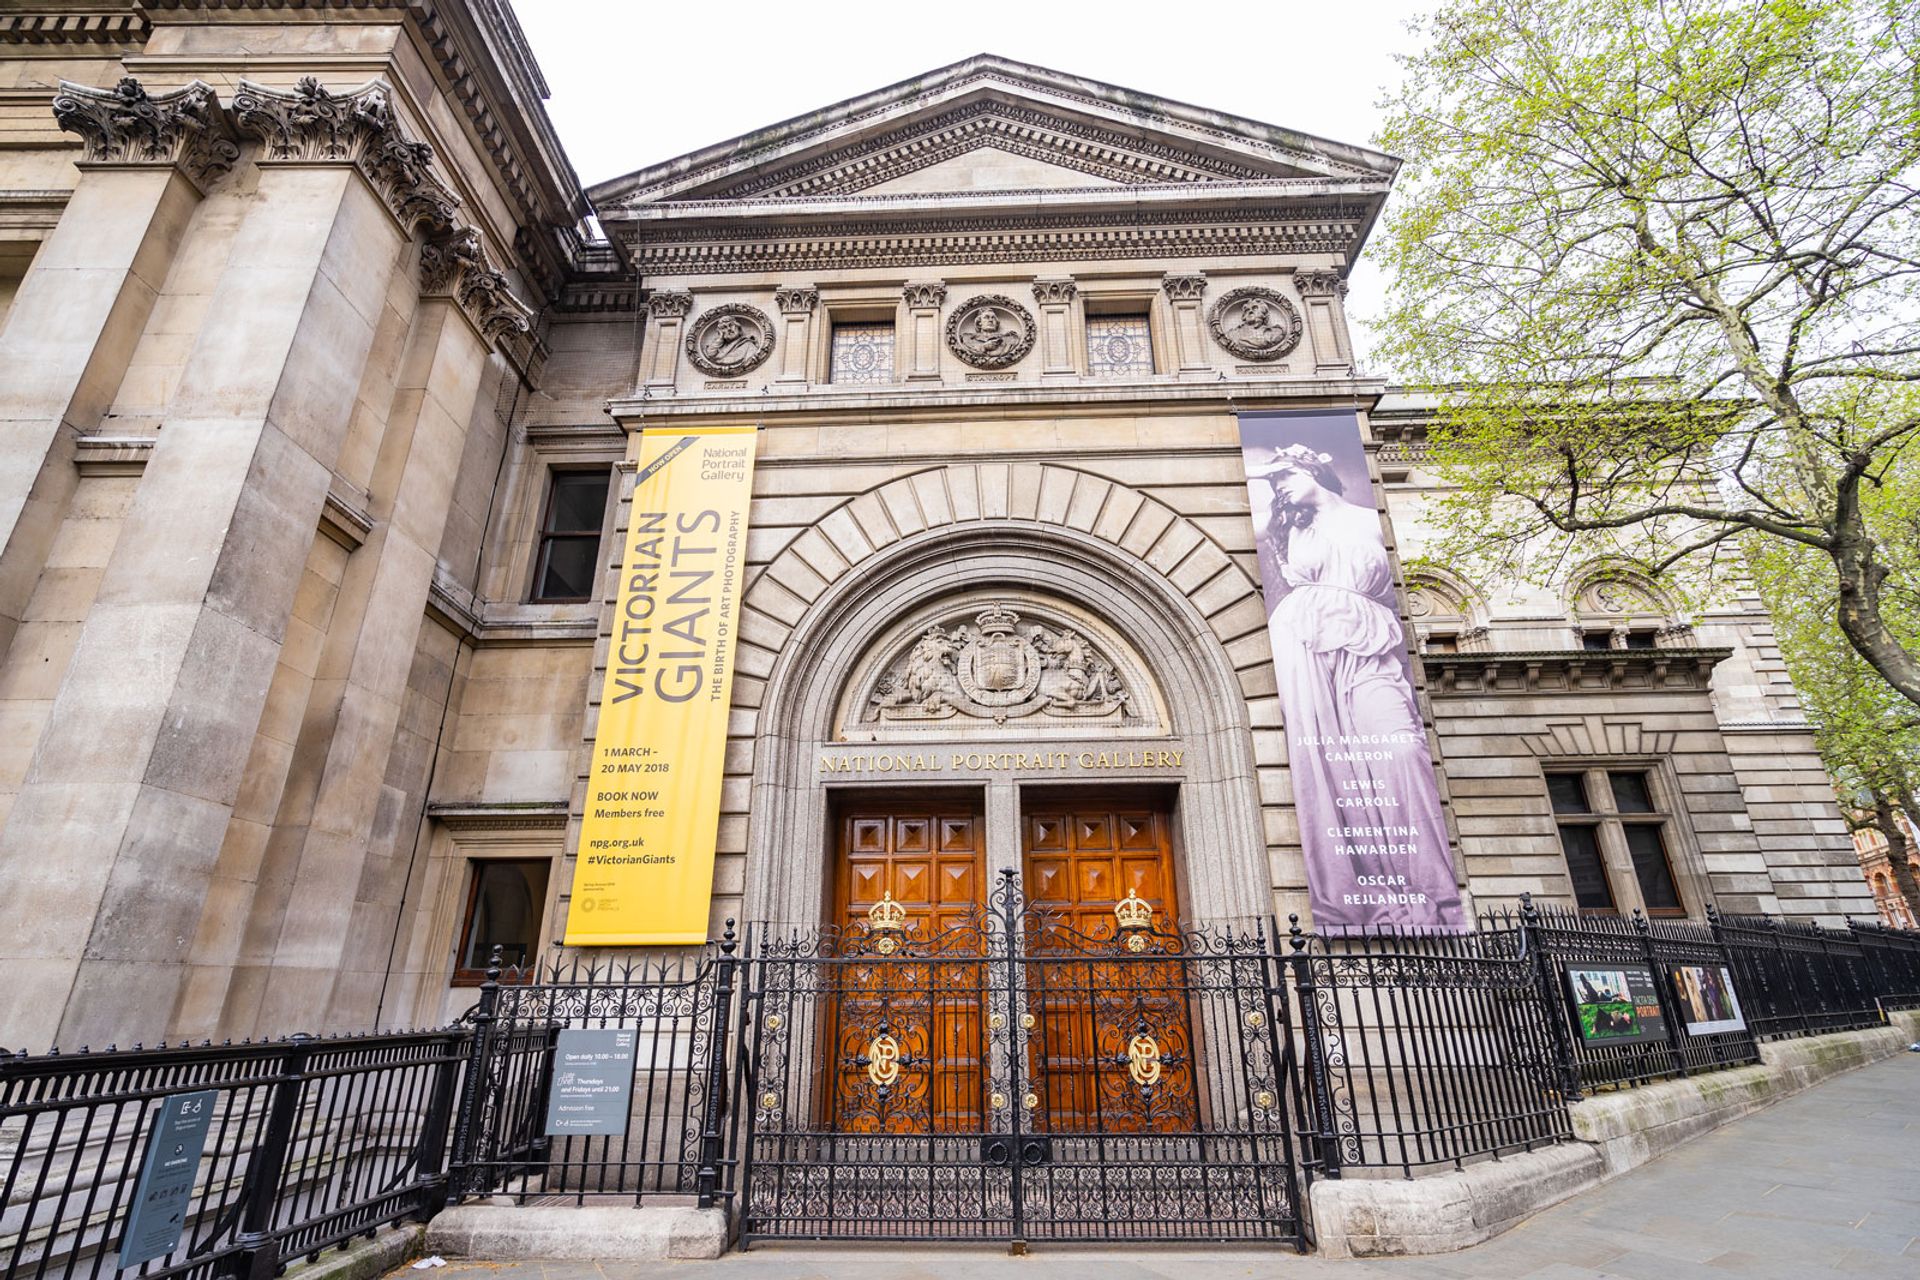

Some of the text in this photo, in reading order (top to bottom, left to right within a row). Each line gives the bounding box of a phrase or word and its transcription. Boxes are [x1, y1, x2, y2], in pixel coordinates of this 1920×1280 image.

[703, 448, 747, 458] National
[648, 445, 683, 474] NOW OPEN
[702, 459, 746, 469] Portrait
[701, 470, 745, 482] Gallery
[612, 512, 668, 704] VICTORIAN
[654, 510, 721, 703] GIANTS
[711, 510, 741, 702] THE BIRTH OF ART PHOTOGRAPHY
[1297, 733, 1415, 746] JULIA MARGARET
[604, 748, 609, 757] 1
[610, 747, 651, 757] MARCH
[1325, 751, 1393, 762] CAMERON
[820, 751, 1185, 773] NATIONAL PORTRAIT GALLERY
[601, 763, 669, 773] 20 MAY 2018
[1343, 780, 1385, 790] LEWIS
[597, 791, 659, 801] BOOK NOW
[1336, 797, 1399, 808] CARROLL
[594, 808, 664, 818] Members free
[1327, 826, 1419, 838] CLEMENTINA
[590, 837, 644, 849] npg.org.uk
[1335, 844, 1417, 856] HAWARDEN
[588, 854, 676, 865] #VictorianGiants
[1357, 875, 1406, 886] OSCAR
[1344, 893, 1427, 905] REJLANDER
[565, 1053, 579, 1061] Open
[580, 1053, 593, 1061] daily
[577, 1078, 604, 1086] Thursdays
